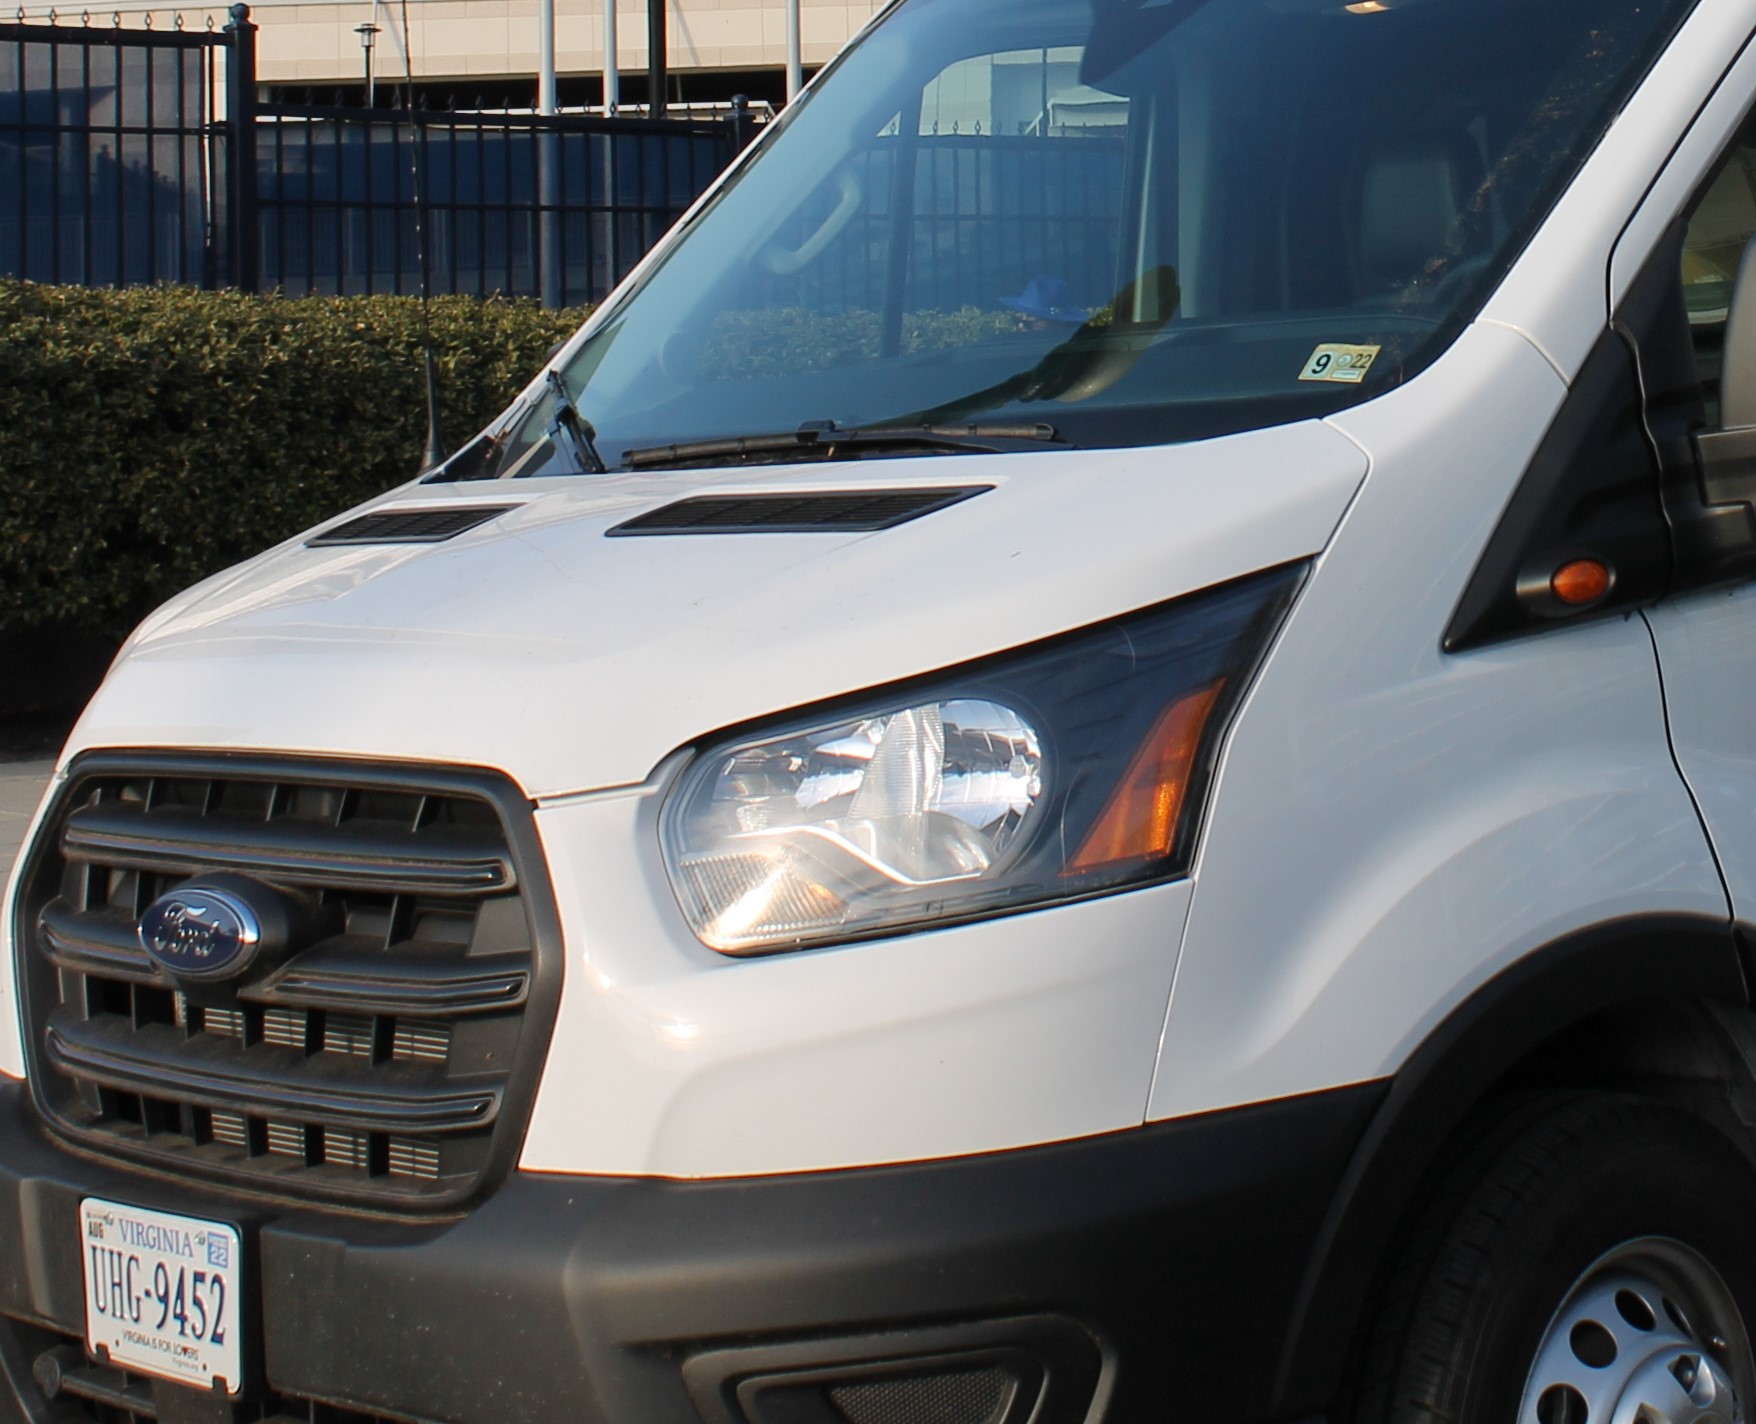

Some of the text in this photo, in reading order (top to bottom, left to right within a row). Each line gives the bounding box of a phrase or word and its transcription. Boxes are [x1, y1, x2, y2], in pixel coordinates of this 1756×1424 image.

[1311, 353, 1332, 375] 9
[1349, 353, 1373, 369] 22
[154, 901, 220, 957] Ford
[88, 1220, 104, 1239] AUG
[118, 1218, 194, 1258] VIRGINIA
[210, 1247, 227, 1266] 22
[91, 1244, 226, 1347] UHG-9452
